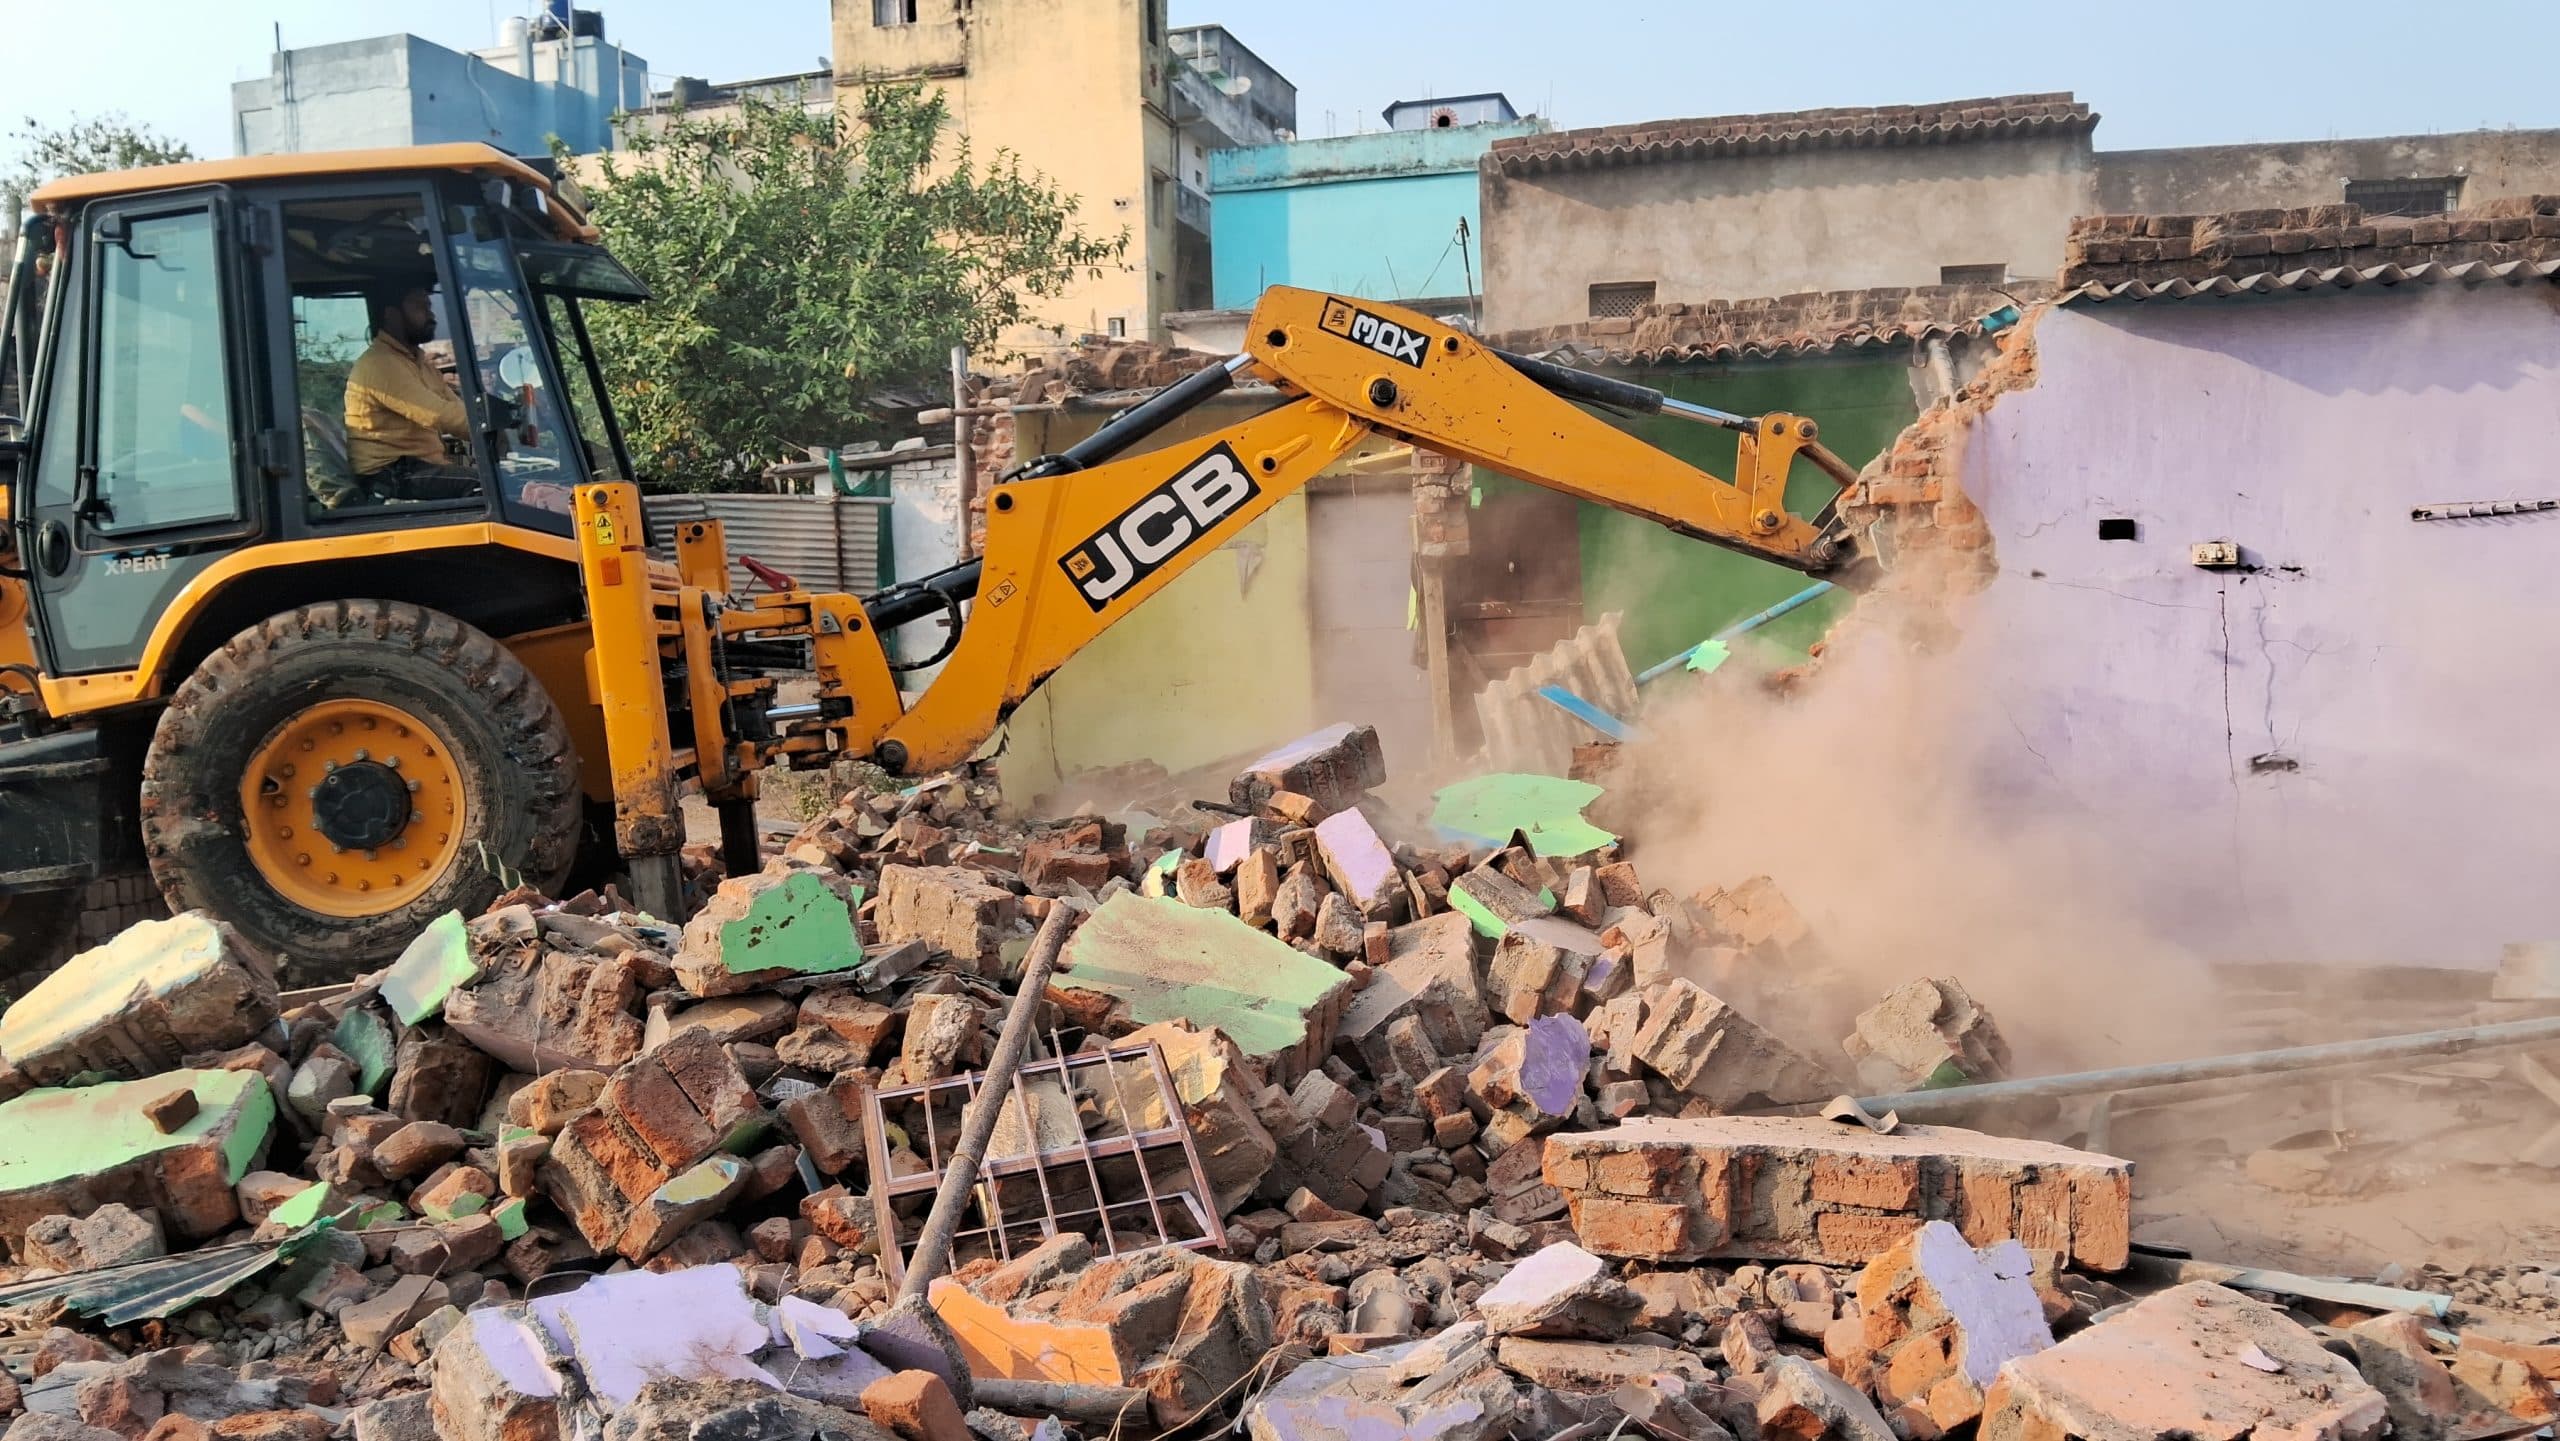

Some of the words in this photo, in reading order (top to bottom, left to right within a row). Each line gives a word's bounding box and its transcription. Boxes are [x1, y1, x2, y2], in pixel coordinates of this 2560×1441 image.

[1352, 313, 1426, 366] 3DX
[1082, 453, 1250, 601] JCB
[103, 553, 171, 577] XPERT
